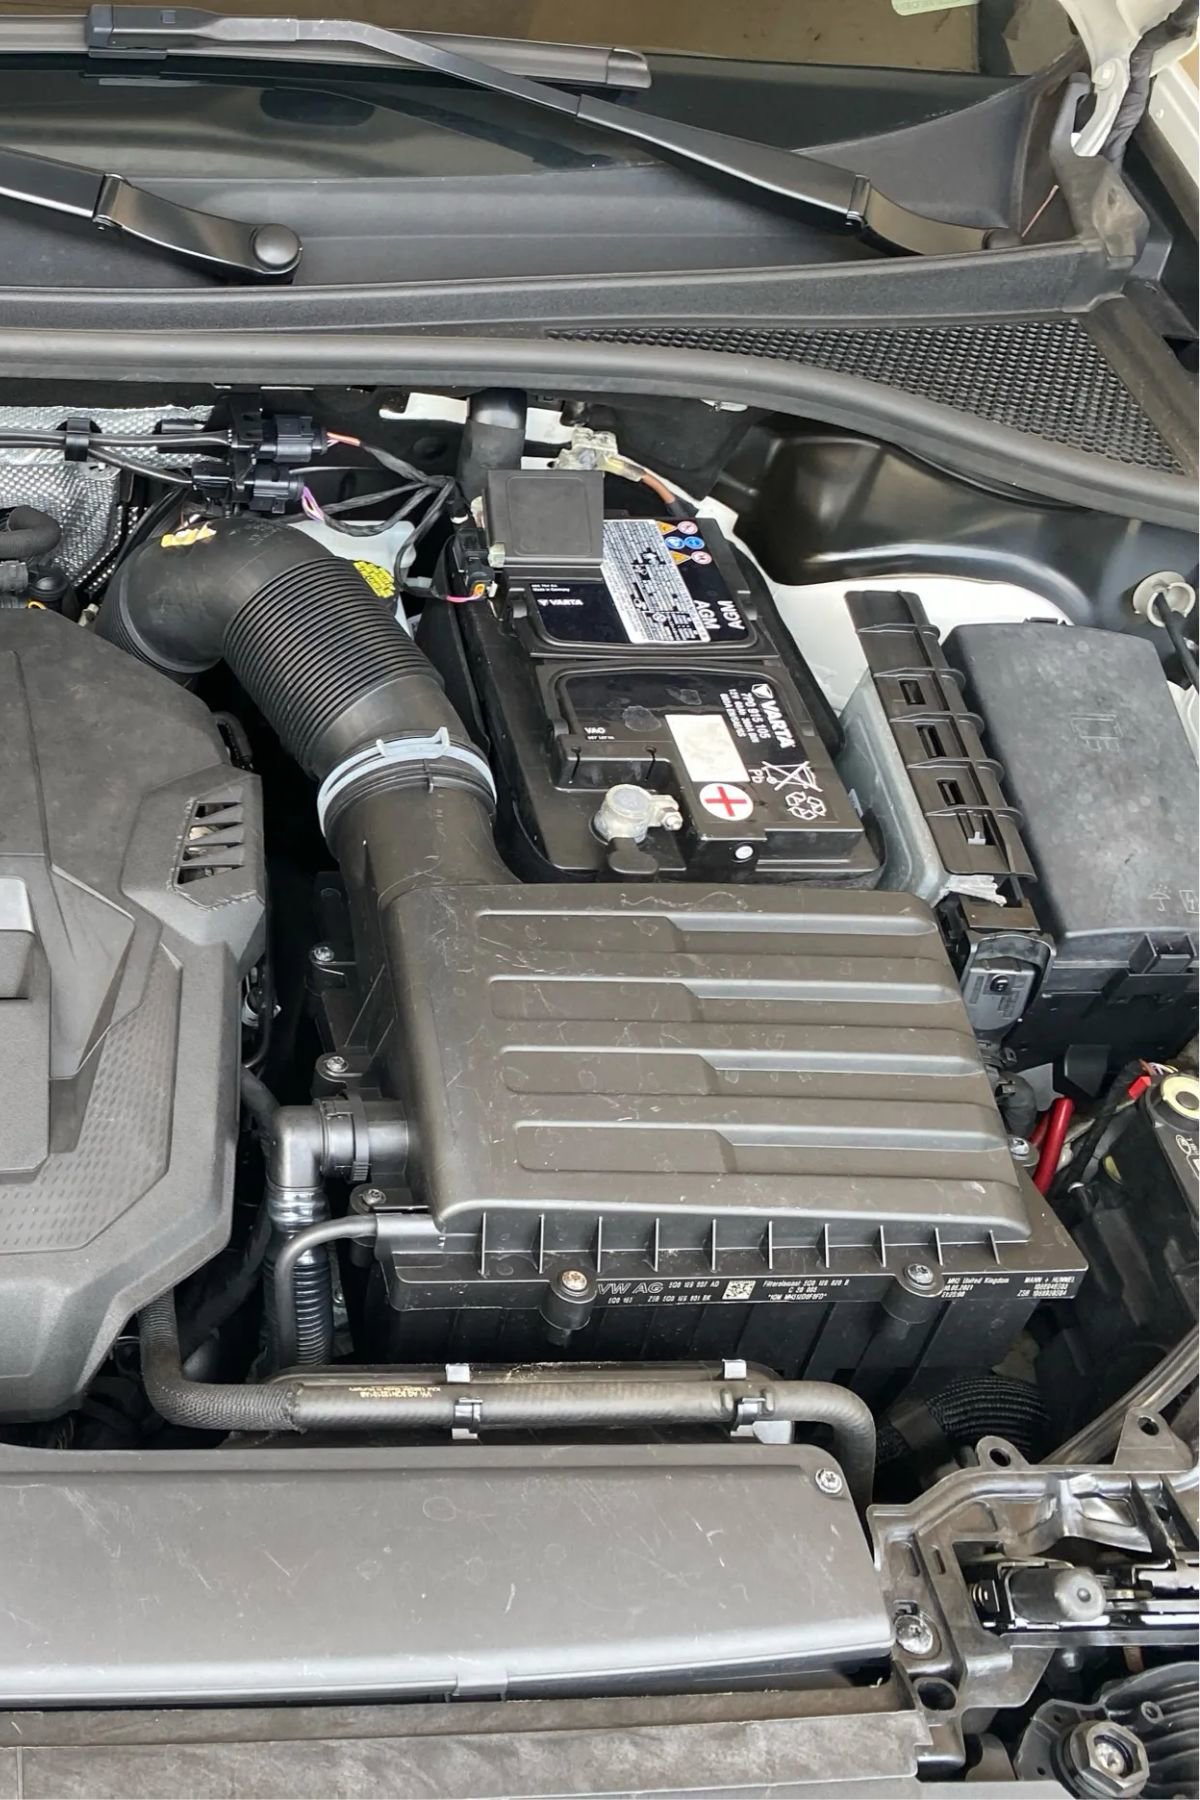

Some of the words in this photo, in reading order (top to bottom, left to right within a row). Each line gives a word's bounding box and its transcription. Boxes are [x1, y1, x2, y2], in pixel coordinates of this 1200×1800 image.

[693, 600, 721, 629] AGM
[717, 600, 746, 630] AGM
[747, 708, 764, 723] 915
[755, 724, 771, 738] 105
[761, 700, 795, 748] VARTA
[748, 769, 765, 783] Pb
[598, 1282, 632, 1295] VW
[632, 1282, 664, 1294] AG
